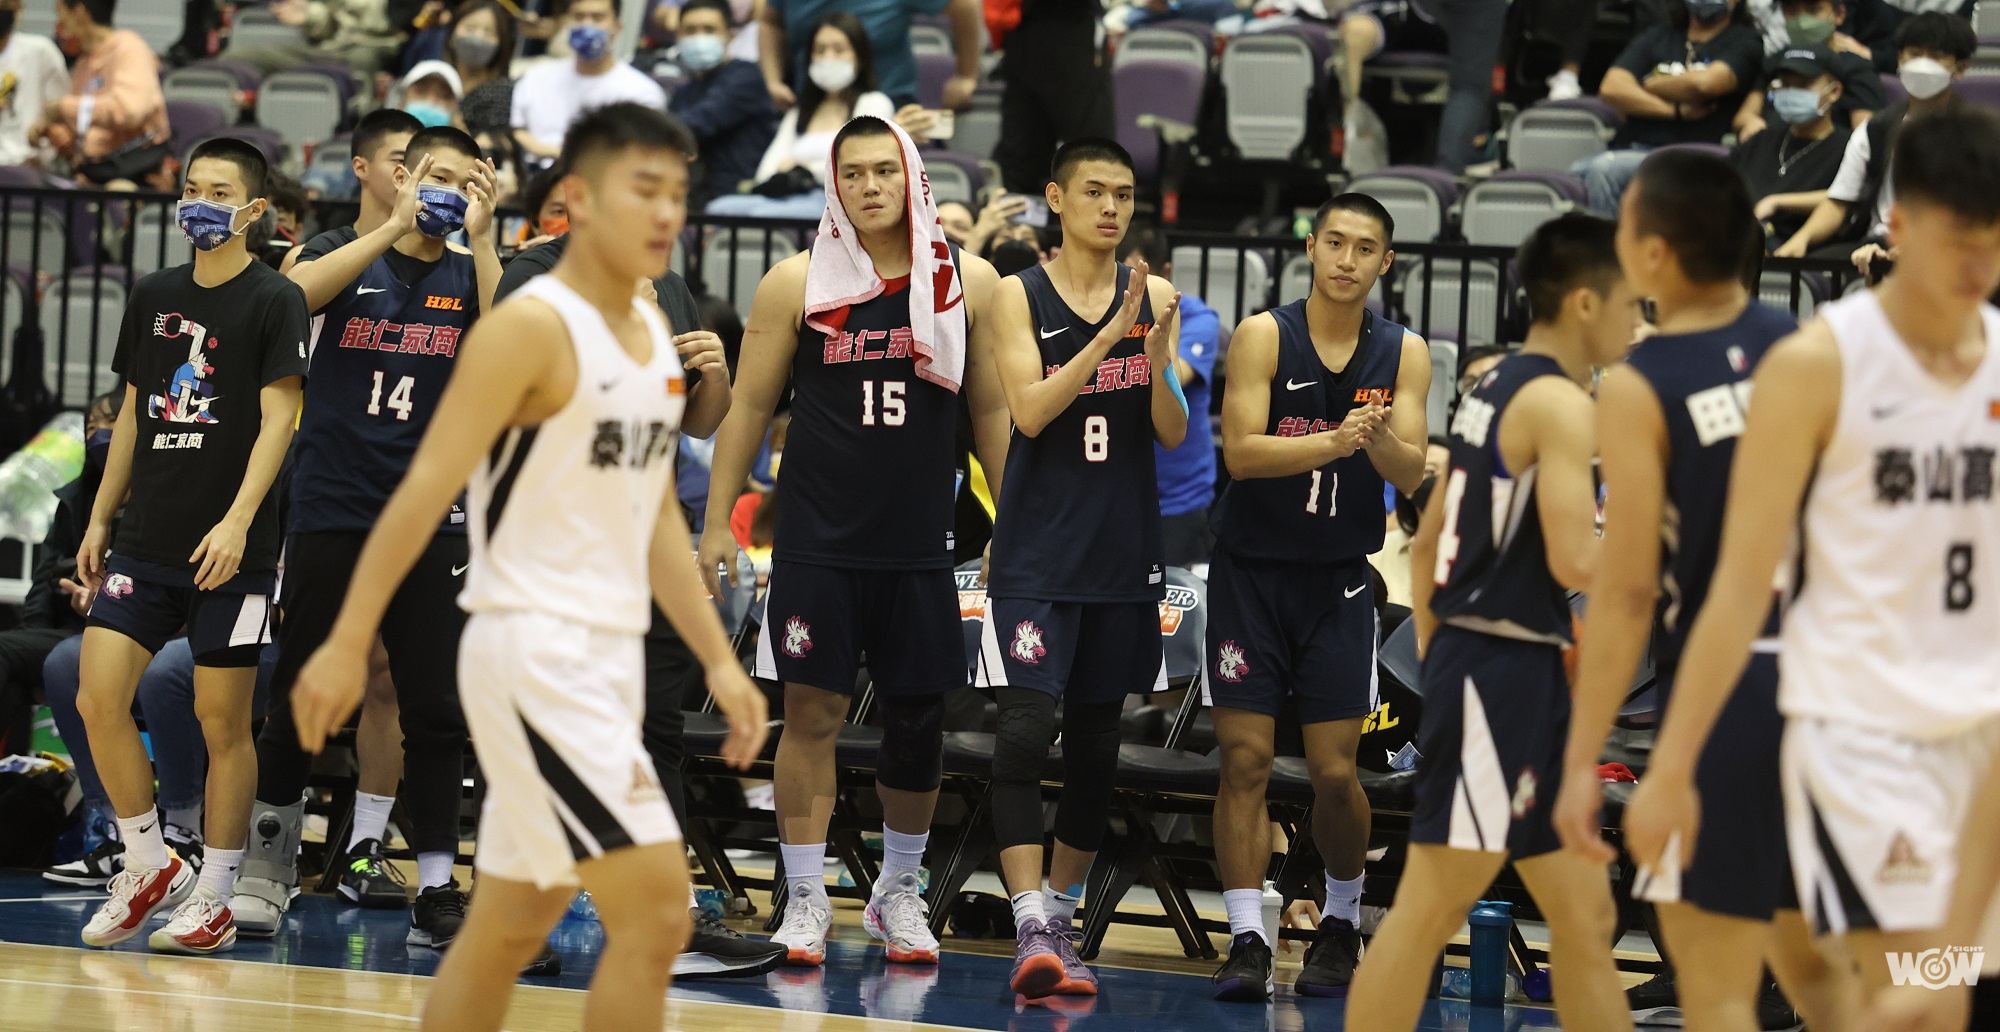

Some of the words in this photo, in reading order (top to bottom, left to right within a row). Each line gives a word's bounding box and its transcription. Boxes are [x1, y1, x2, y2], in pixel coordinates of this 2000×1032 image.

[339, 316, 462, 359] 能仁家商
[366, 370, 415, 422] 14
[862, 380, 907, 427] 15
[152, 432, 205, 450] 能仁家商
[1083, 415, 1109, 462] 8
[1306, 469, 1339, 517] 11
[1944, 543, 1975, 614] 8
